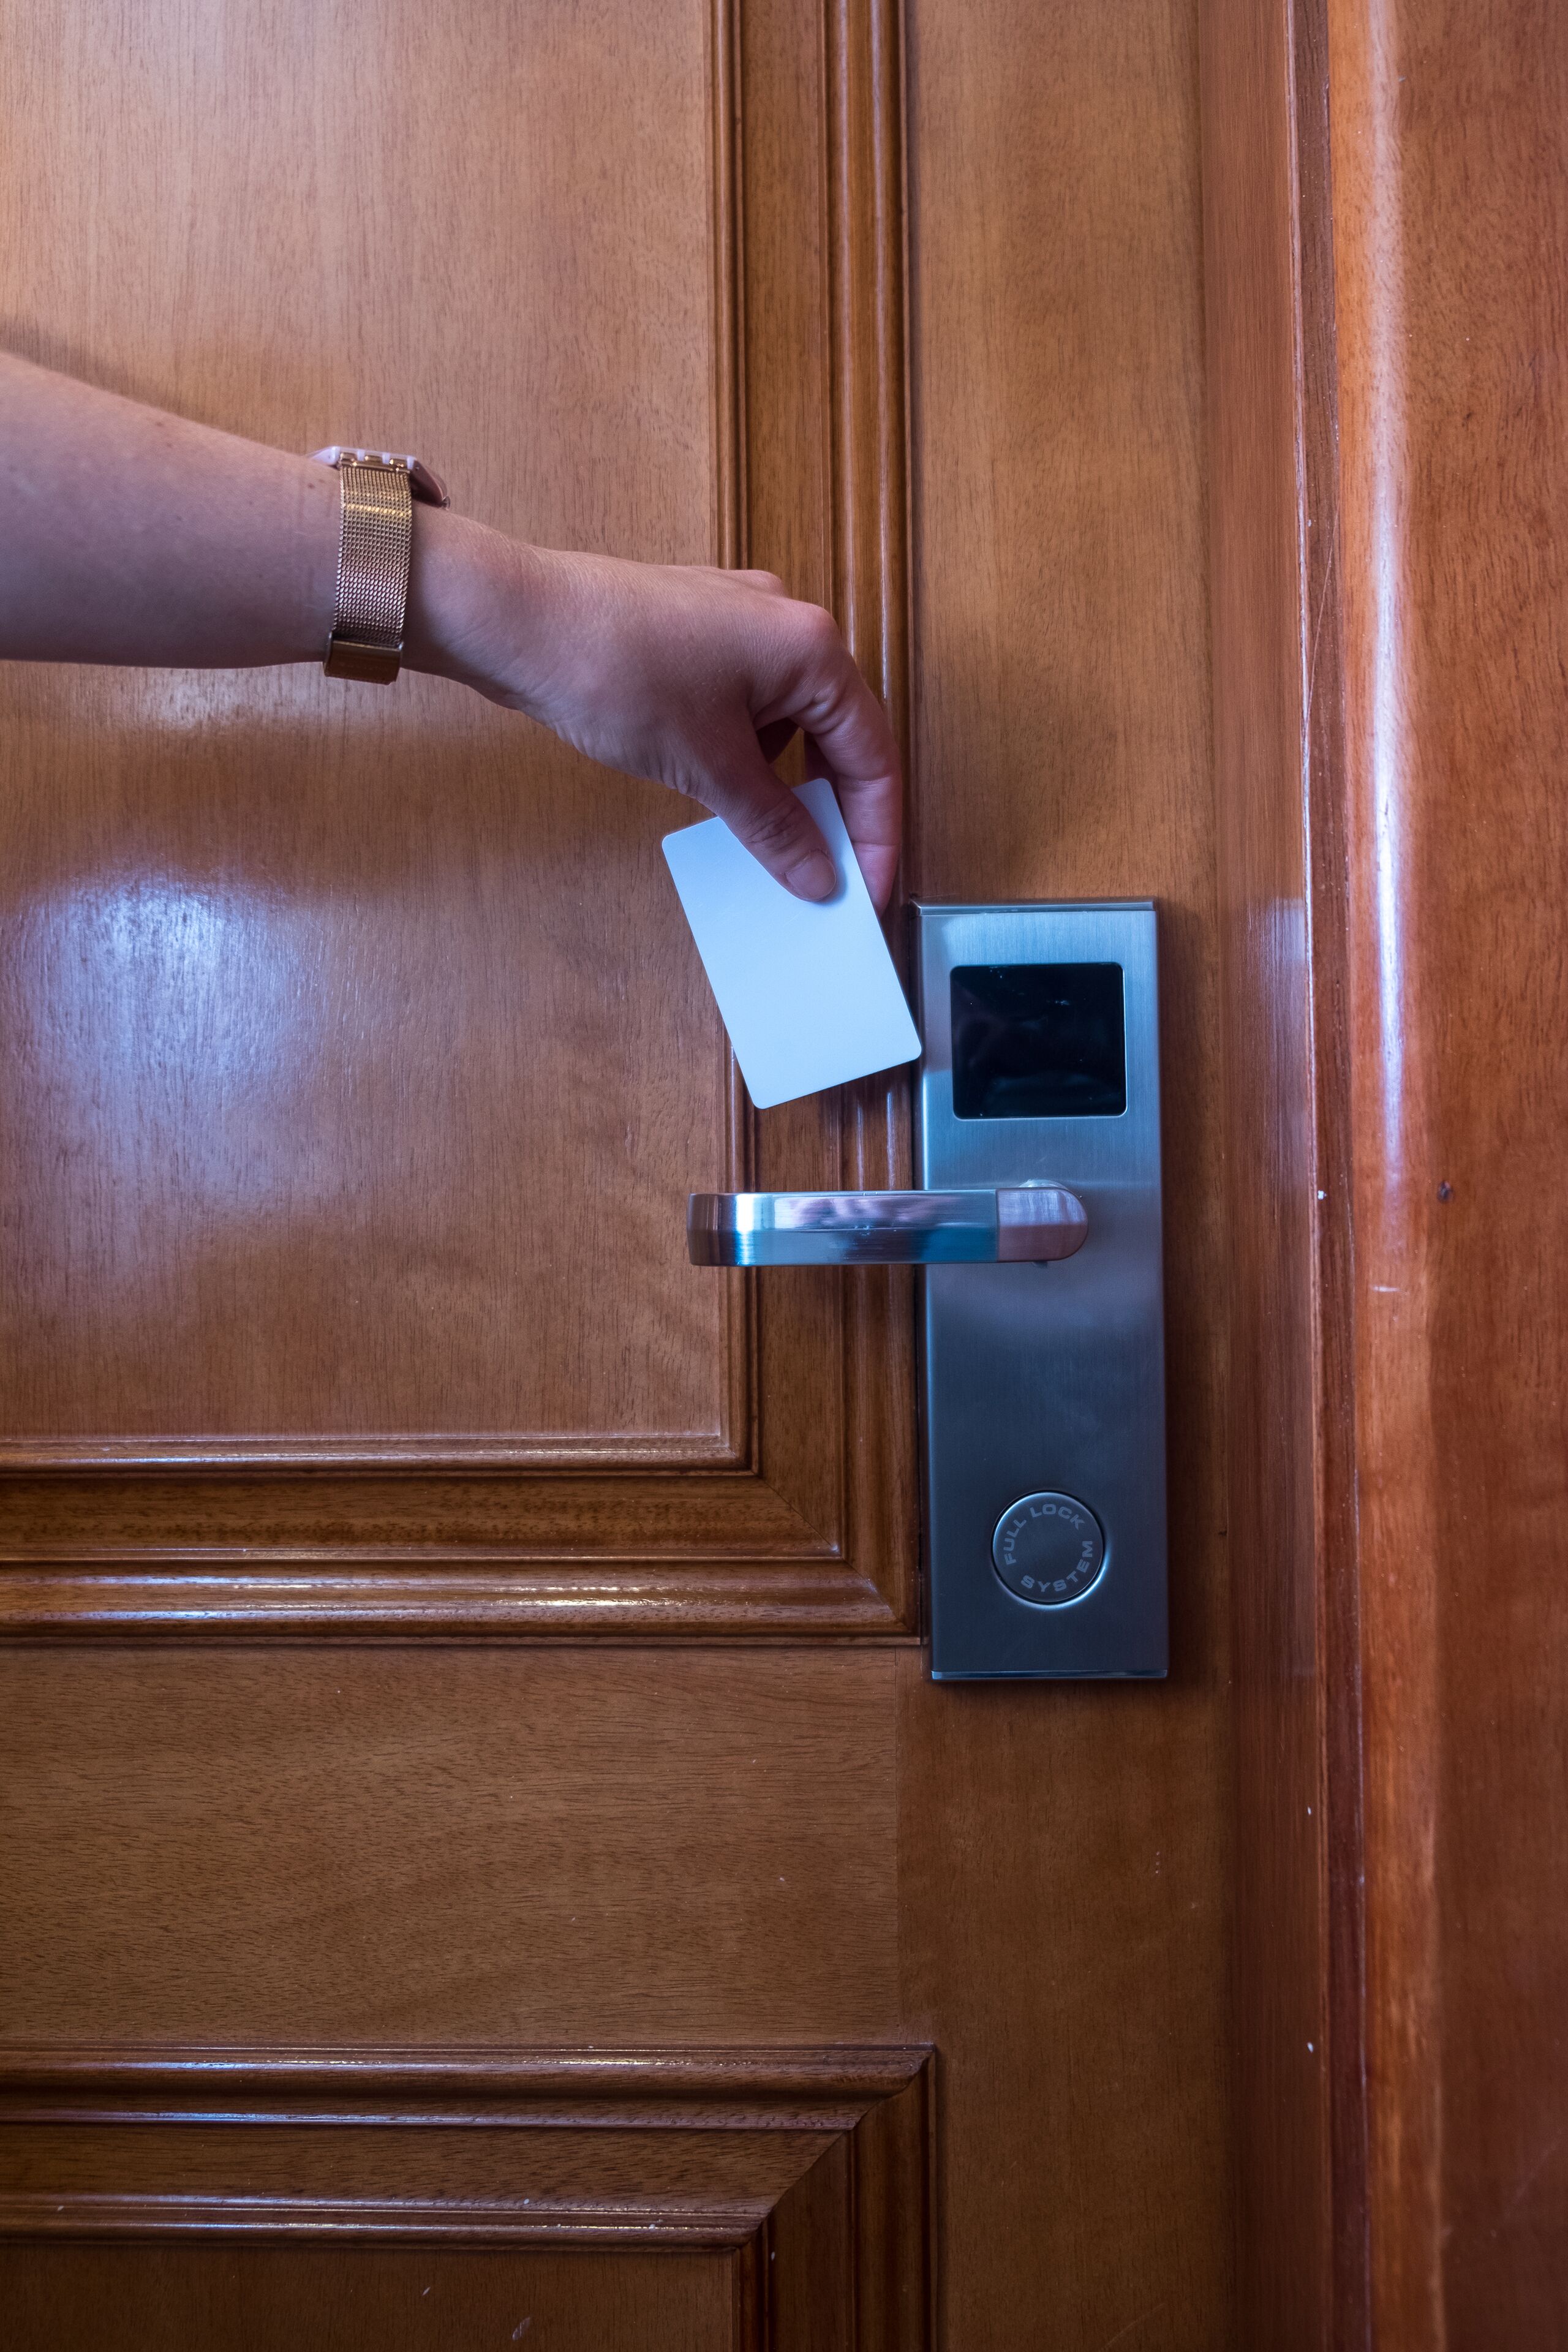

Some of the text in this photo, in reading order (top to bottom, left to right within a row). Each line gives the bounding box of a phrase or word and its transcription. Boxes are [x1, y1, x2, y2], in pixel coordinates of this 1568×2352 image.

[1003, 1504, 1085, 1565] FULL LOCK
[1020, 1540, 1093, 1593] SYSTEM
